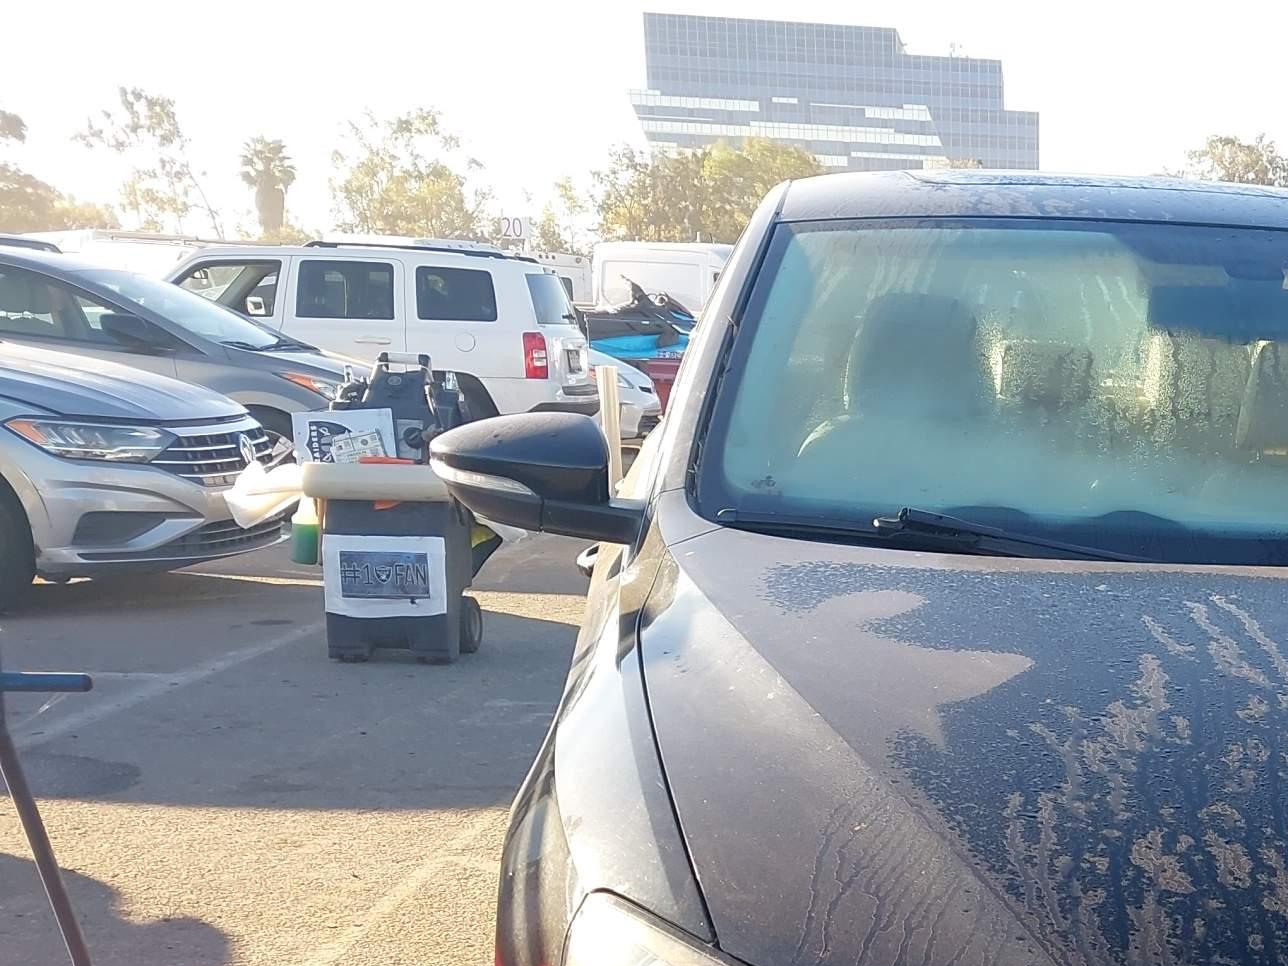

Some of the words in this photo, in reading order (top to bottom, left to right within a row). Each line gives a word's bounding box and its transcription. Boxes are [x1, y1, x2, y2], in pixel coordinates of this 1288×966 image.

[502, 217, 522, 238] 20
[340, 562, 374, 585] #1
[394, 562, 428, 585] FAN
